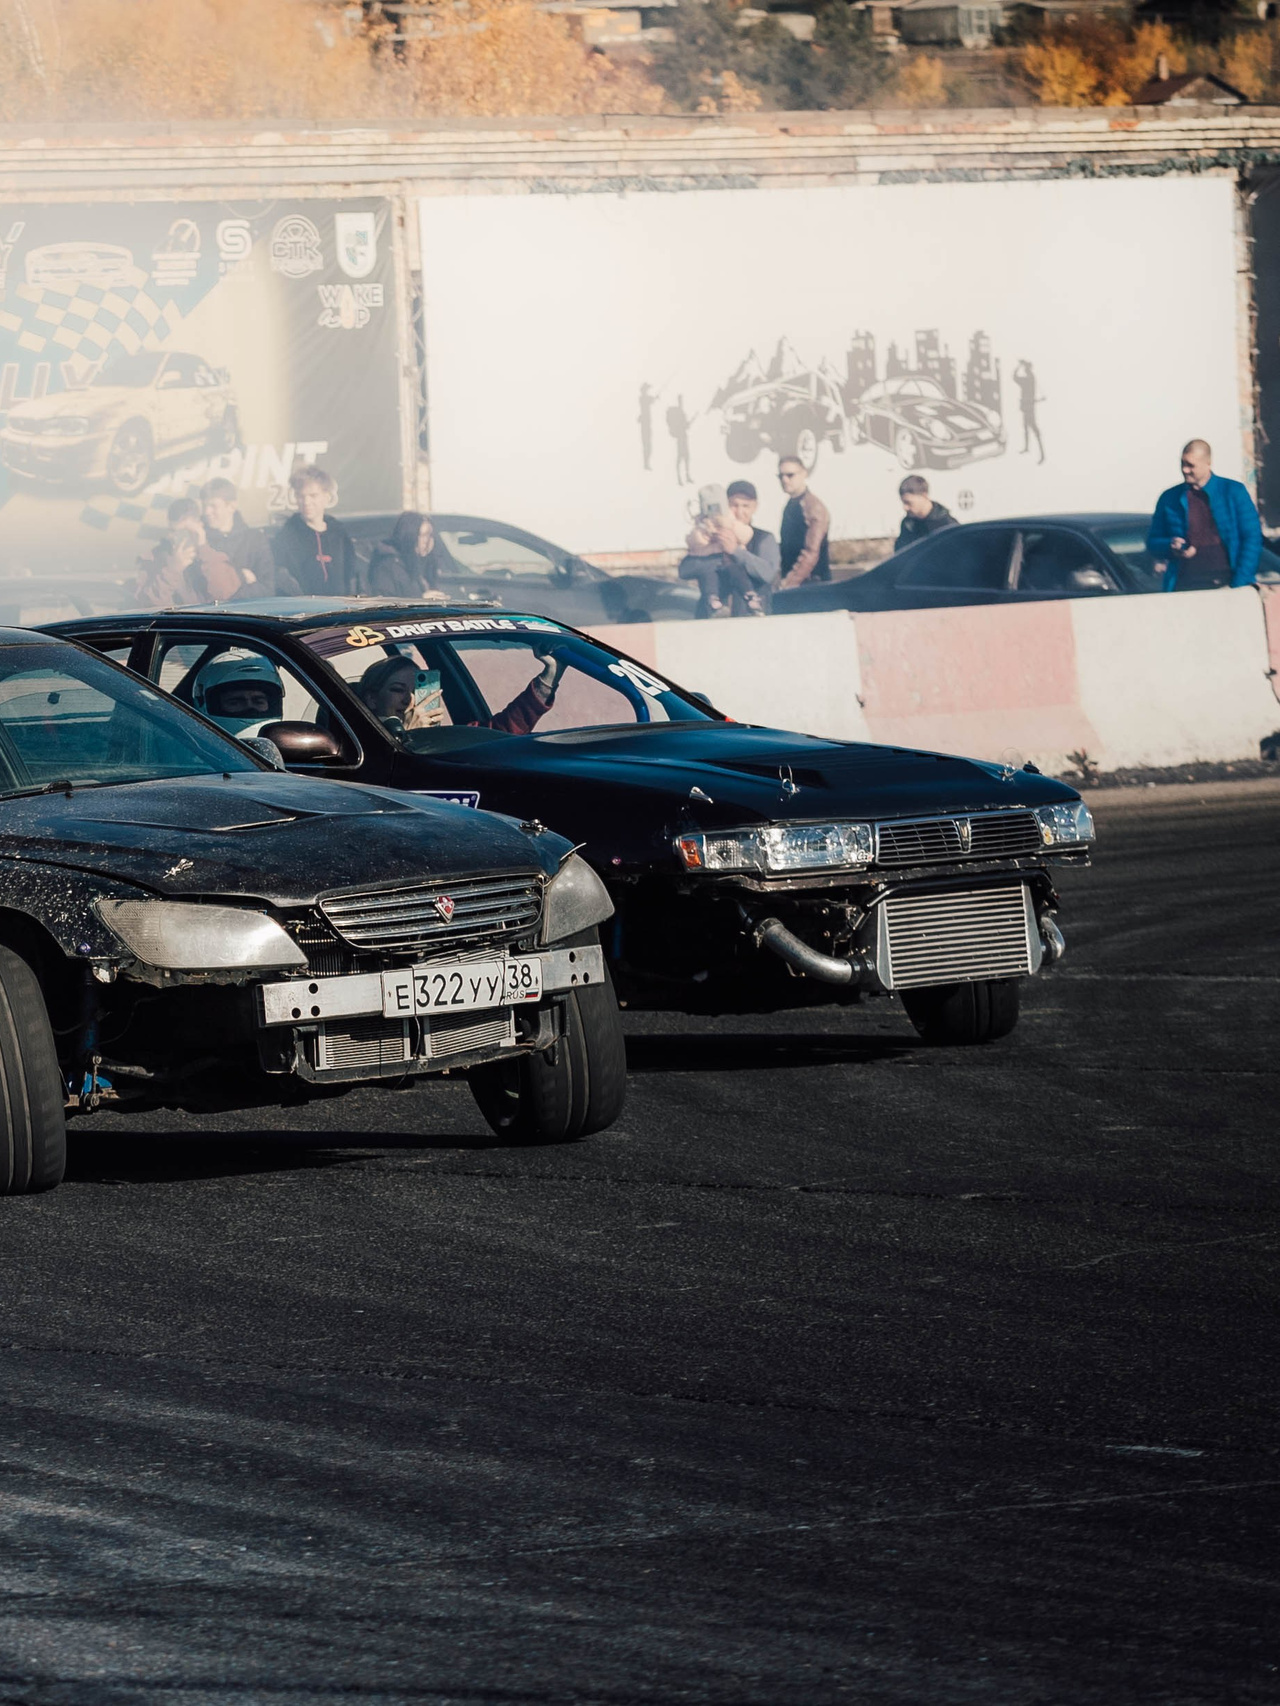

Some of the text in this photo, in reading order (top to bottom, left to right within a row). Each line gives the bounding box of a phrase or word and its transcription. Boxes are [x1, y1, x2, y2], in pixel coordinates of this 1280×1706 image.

[142, 441, 328, 494] PRINT
[267, 484, 339, 510] 203
[386, 621, 447, 639] DRIFT
[444, 619, 517, 632] BATTLE
[608, 659, 671, 697] 20
[507, 963, 533, 990] 38
[506, 990, 525, 1000] RUS
